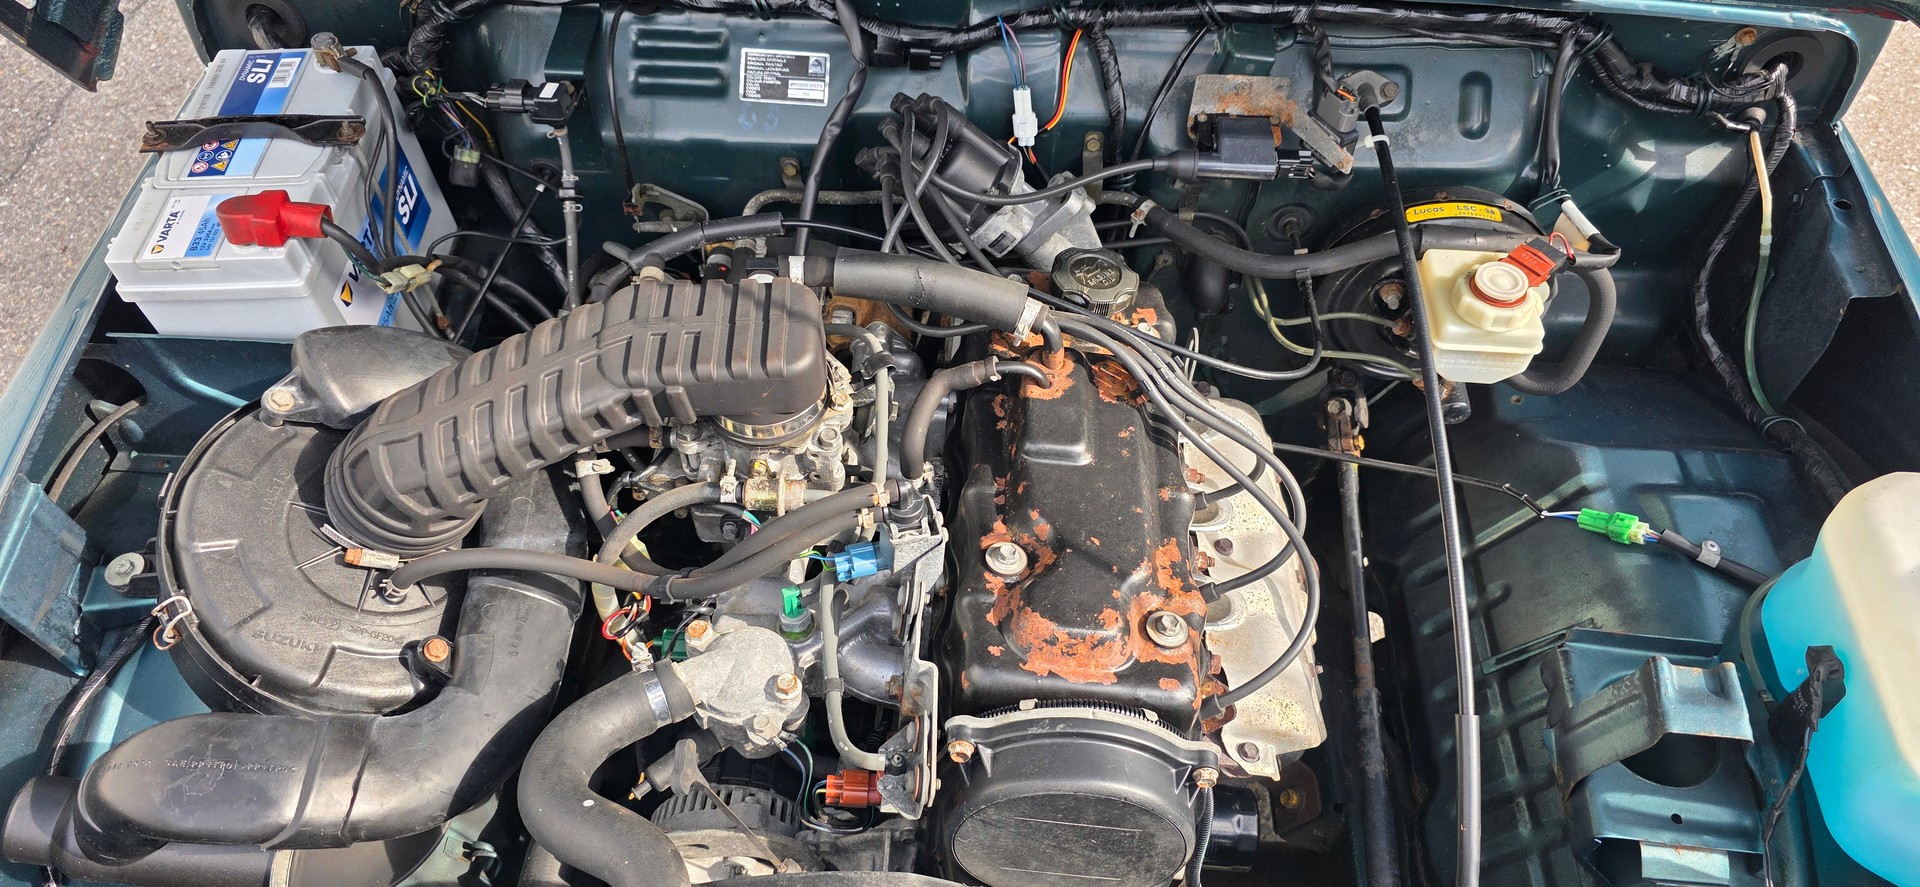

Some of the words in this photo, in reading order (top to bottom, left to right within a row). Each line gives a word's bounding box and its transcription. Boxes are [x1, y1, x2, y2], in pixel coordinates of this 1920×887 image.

[239, 60, 255, 81] DYNAMIC
[246, 58, 274, 84] SLI
[397, 172, 418, 225] SLI
[1413, 206, 1445, 216] Lucas
[1456, 204, 1477, 212] LSC
[156, 210, 181, 243] VARTA
[189, 236, 202, 252] B33
[198, 217, 211, 236] 45Ah
[251, 628, 321, 654] SUZUKI
